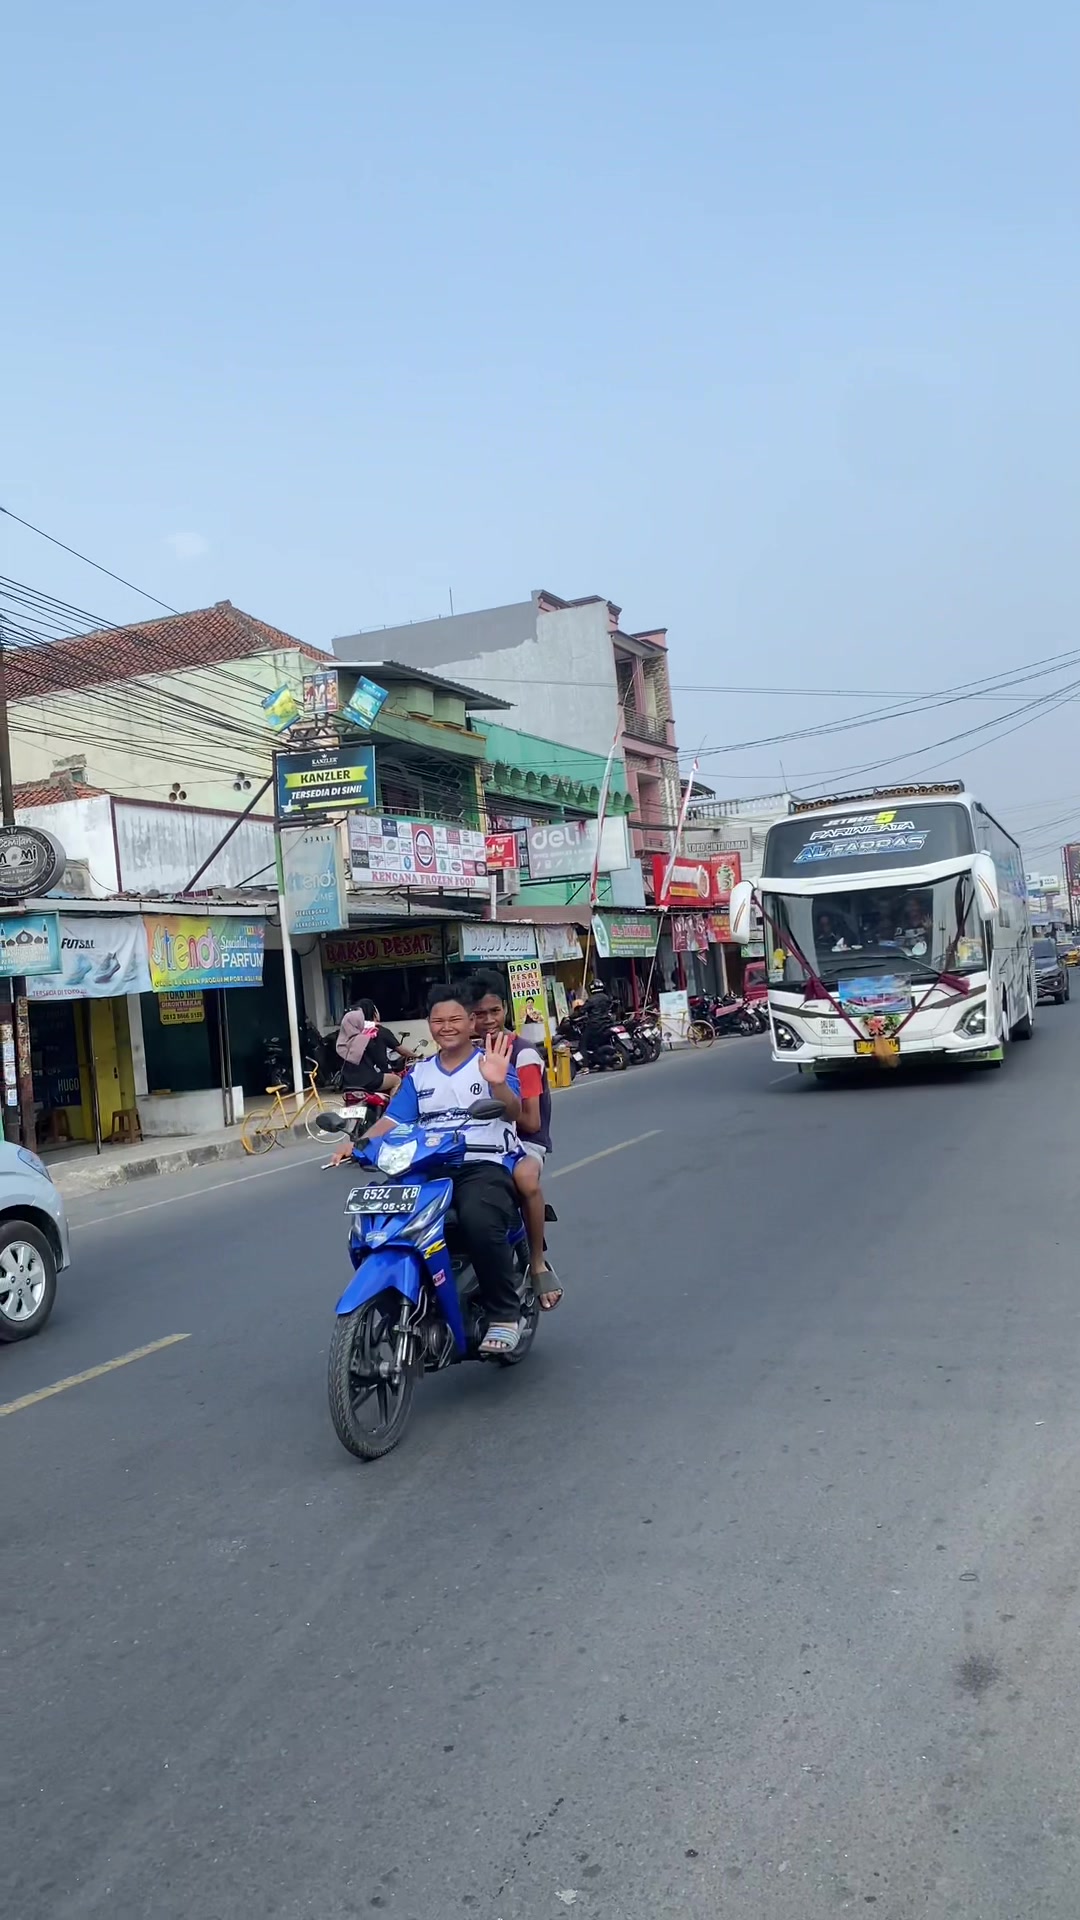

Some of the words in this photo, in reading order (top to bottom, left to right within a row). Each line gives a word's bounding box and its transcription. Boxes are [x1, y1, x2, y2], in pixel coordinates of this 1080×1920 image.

[301, 770, 351, 784] KANZLER
[291, 788, 330, 800] TERSEDIA
[331, 787, 340, 797] DI
[340, 785, 362, 795] SINI!
[809, 821, 915, 841] PARIWISATA
[531, 827, 580, 850] deli
[726, 840, 748, 850] DAMAI
[371, 870, 418, 884] KENCANA
[420, 875, 453, 885] FROZEN
[455, 878, 476, 887] FOOD
[61, 938, 95, 949] FUTSAL
[326, 940, 378, 963] BAKSO
[381, 934, 432, 958] PESAT
[509, 962, 537, 973] BASO
[511, 971, 538, 982] PESAT
[513, 988, 541, 998] LEZAAT
[349, 1190, 359, 1201] F
[363, 1188, 392, 1200] 6524
[402, 1187, 419, 1200] KB
